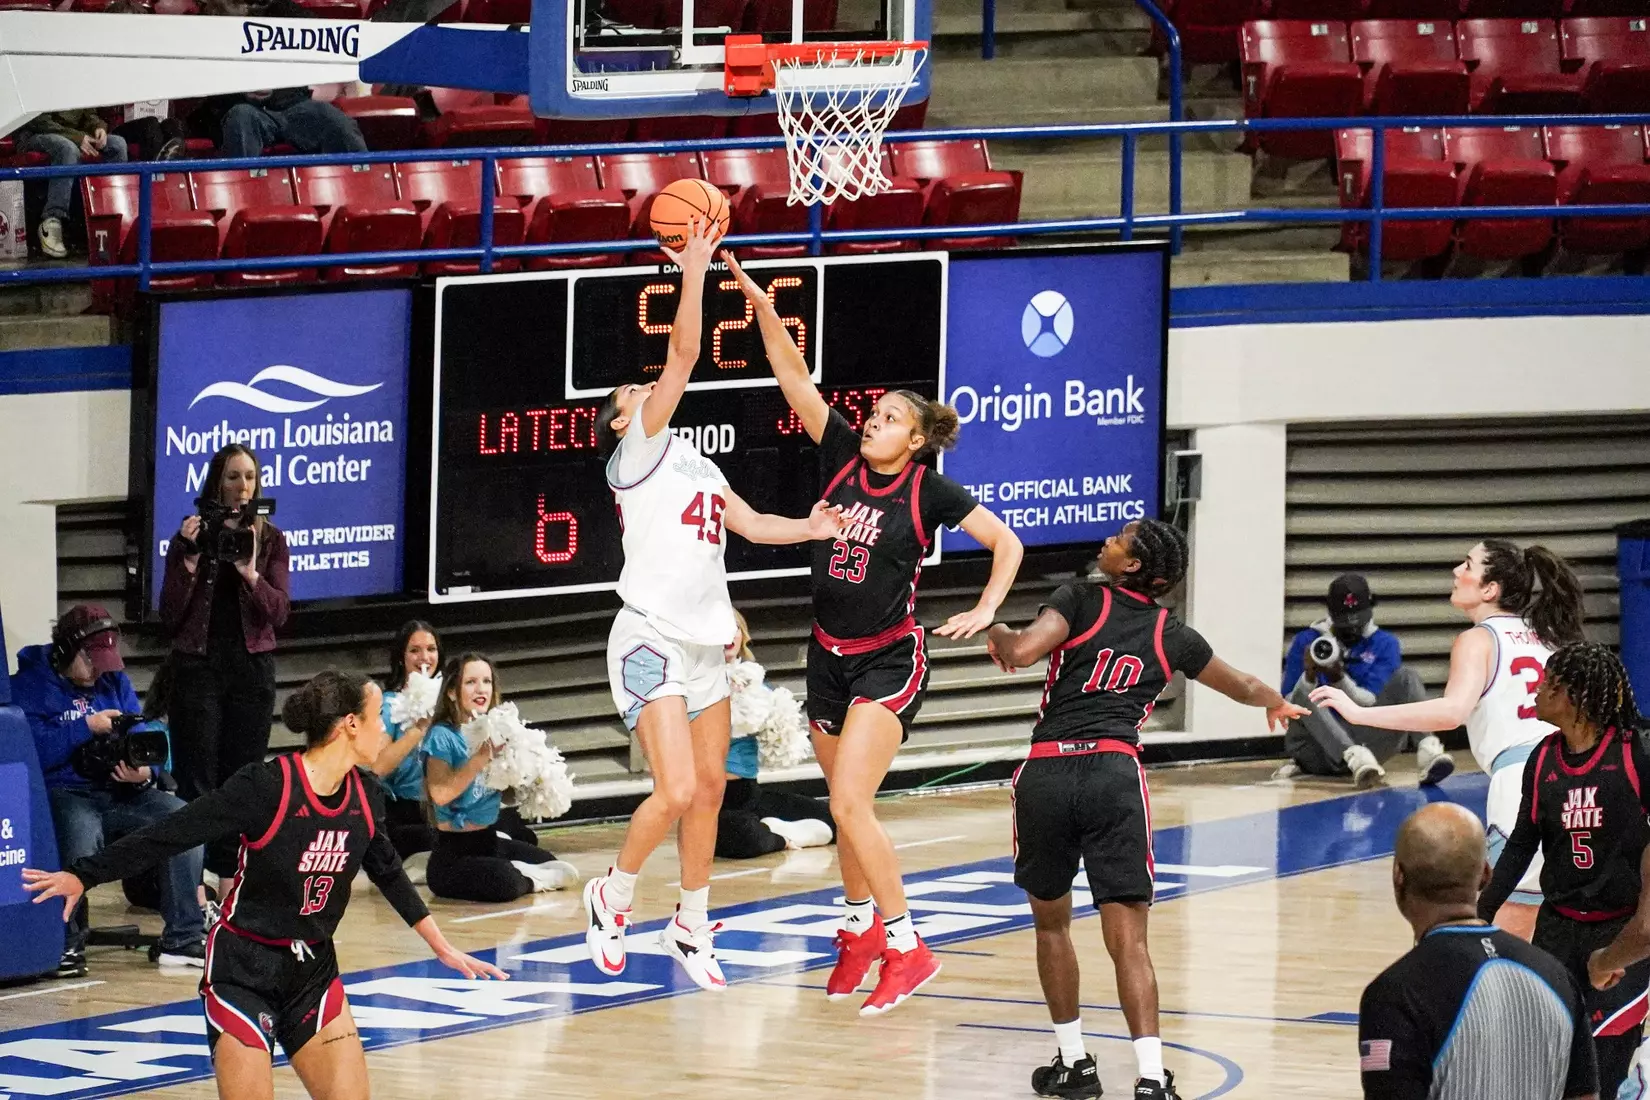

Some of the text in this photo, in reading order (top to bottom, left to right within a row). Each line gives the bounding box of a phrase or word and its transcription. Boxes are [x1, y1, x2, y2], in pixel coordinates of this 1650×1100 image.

[241, 21, 360, 58] SPALDING
[572, 78, 608, 92] SPALDING
[663, 261, 730, 274] DANIC
[949, 374, 1145, 432] Origin Bank
[166, 412, 394, 456] Northern Louisiana
[671, 424, 736, 454] RIOD
[288, 454, 371, 485] Center
[999, 477, 1079, 501] OFFICIAL
[1083, 474, 1132, 496] BANK
[681, 491, 726, 545] 45
[843, 501, 885, 527] JAX
[1002, 500, 1145, 528] TECH ATHLETICS
[311, 524, 395, 546] PROVIDER
[840, 521, 882, 546] TATE
[289, 550, 370, 572] THLETICS
[828, 539, 870, 583] 23
[1081, 647, 1144, 694] 10
[1563, 786, 1598, 811] JAX
[1, 818, 14, 840] &
[309, 830, 350, 852] JAX
[298, 851, 350, 872] STATE
[1569, 831, 1594, 869] 5
[299, 875, 334, 915] 13
